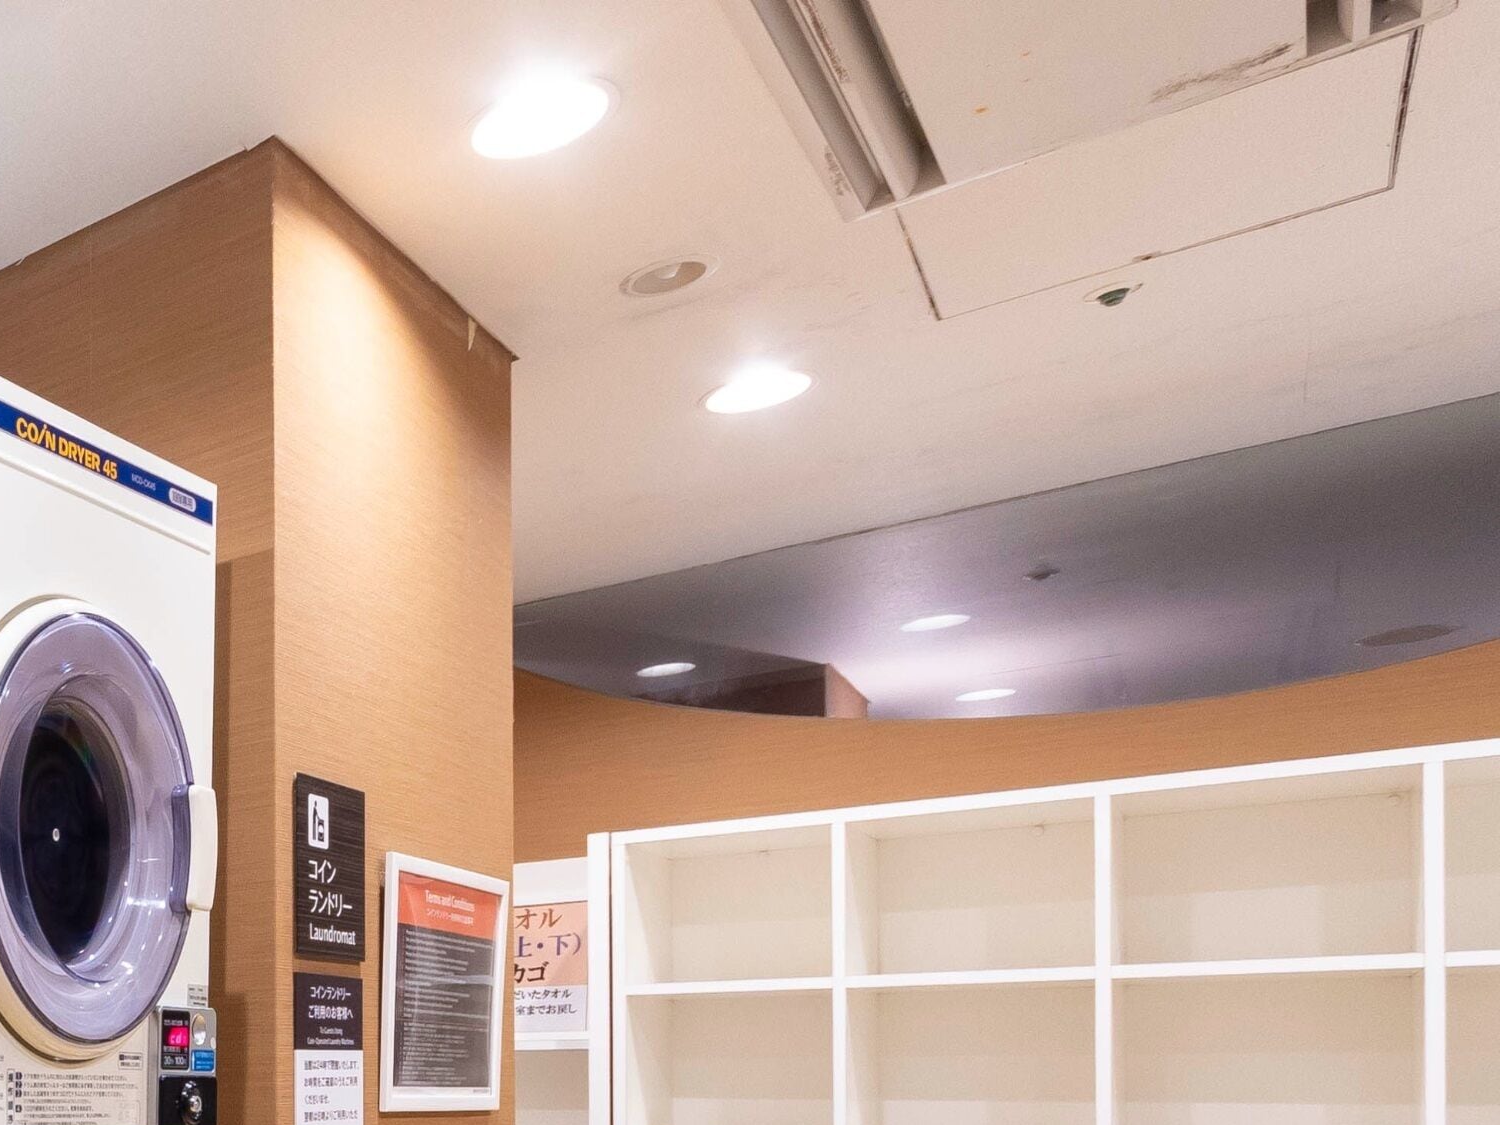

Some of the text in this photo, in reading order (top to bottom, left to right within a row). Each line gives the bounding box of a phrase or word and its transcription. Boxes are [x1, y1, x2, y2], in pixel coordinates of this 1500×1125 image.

[58, 437, 100, 473] DRYER
[102, 459, 118, 480] 45
[308, 859, 337, 884] コイン
[308, 889, 353, 917] ランドリー
[516, 908, 562, 930] オル
[309, 922, 356, 946] Laundromat
[514, 932, 581, 958] 上・下)
[310, 986, 352, 1001] コインランドリー
[308, 1005, 354, 1020] ご利用のお客様へ
